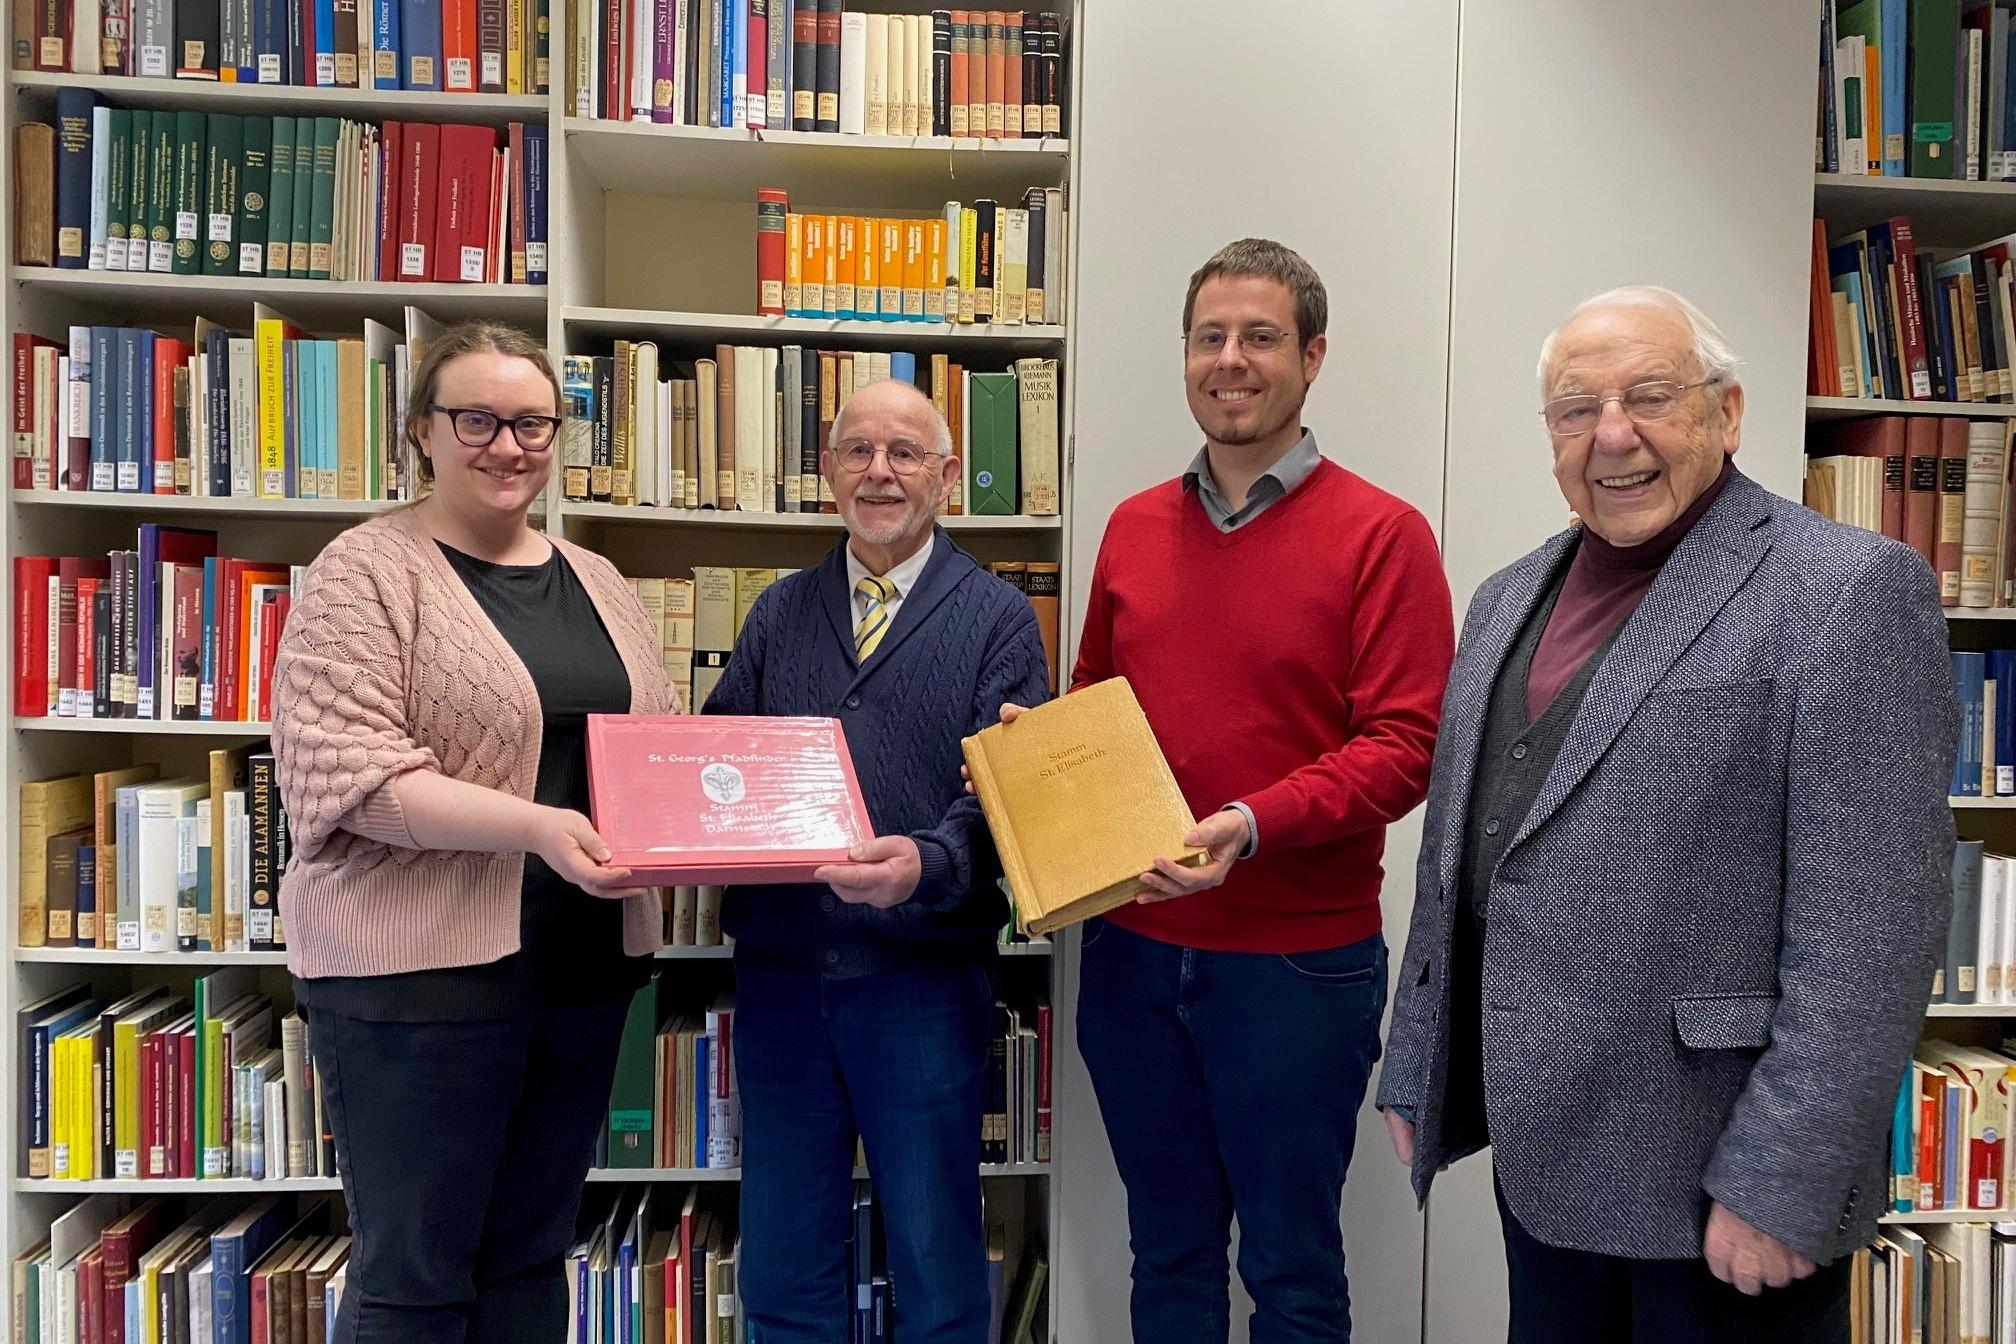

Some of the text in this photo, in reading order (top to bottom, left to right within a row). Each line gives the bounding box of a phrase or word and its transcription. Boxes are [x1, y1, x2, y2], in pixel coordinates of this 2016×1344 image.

[379, 2, 389, 34] Römer
[610, 10, 619, 45] Ludwigs
[658, 10, 667, 43] ERNST
[980, 232, 989, 276] Der Kunstführer
[266, 335, 275, 374] FREIHEIT
[1024, 371, 1052, 380] RIEMANN
[1025, 381, 1052, 391] MUSIK
[18, 382, 26, 395] der
[1022, 392, 1054, 401] LEXIKON
[18, 397, 26, 418] Geist
[1036, 405, 1041, 414] 1
[19, 421, 26, 430] Im
[267, 446, 277, 468] 1848
[614, 430, 626, 465] Wallis
[1031, 472, 1046, 482] A-K
[1039, 748, 1106, 780] St. Elisabeth
[1048, 743, 1087, 763] Stamm
[709, 803, 758, 812] Stamm
[254, 764, 268, 883] DIE ALAMANNEN
[277, 808, 285, 832] Hessen
[277, 840, 285, 869] Romanik
